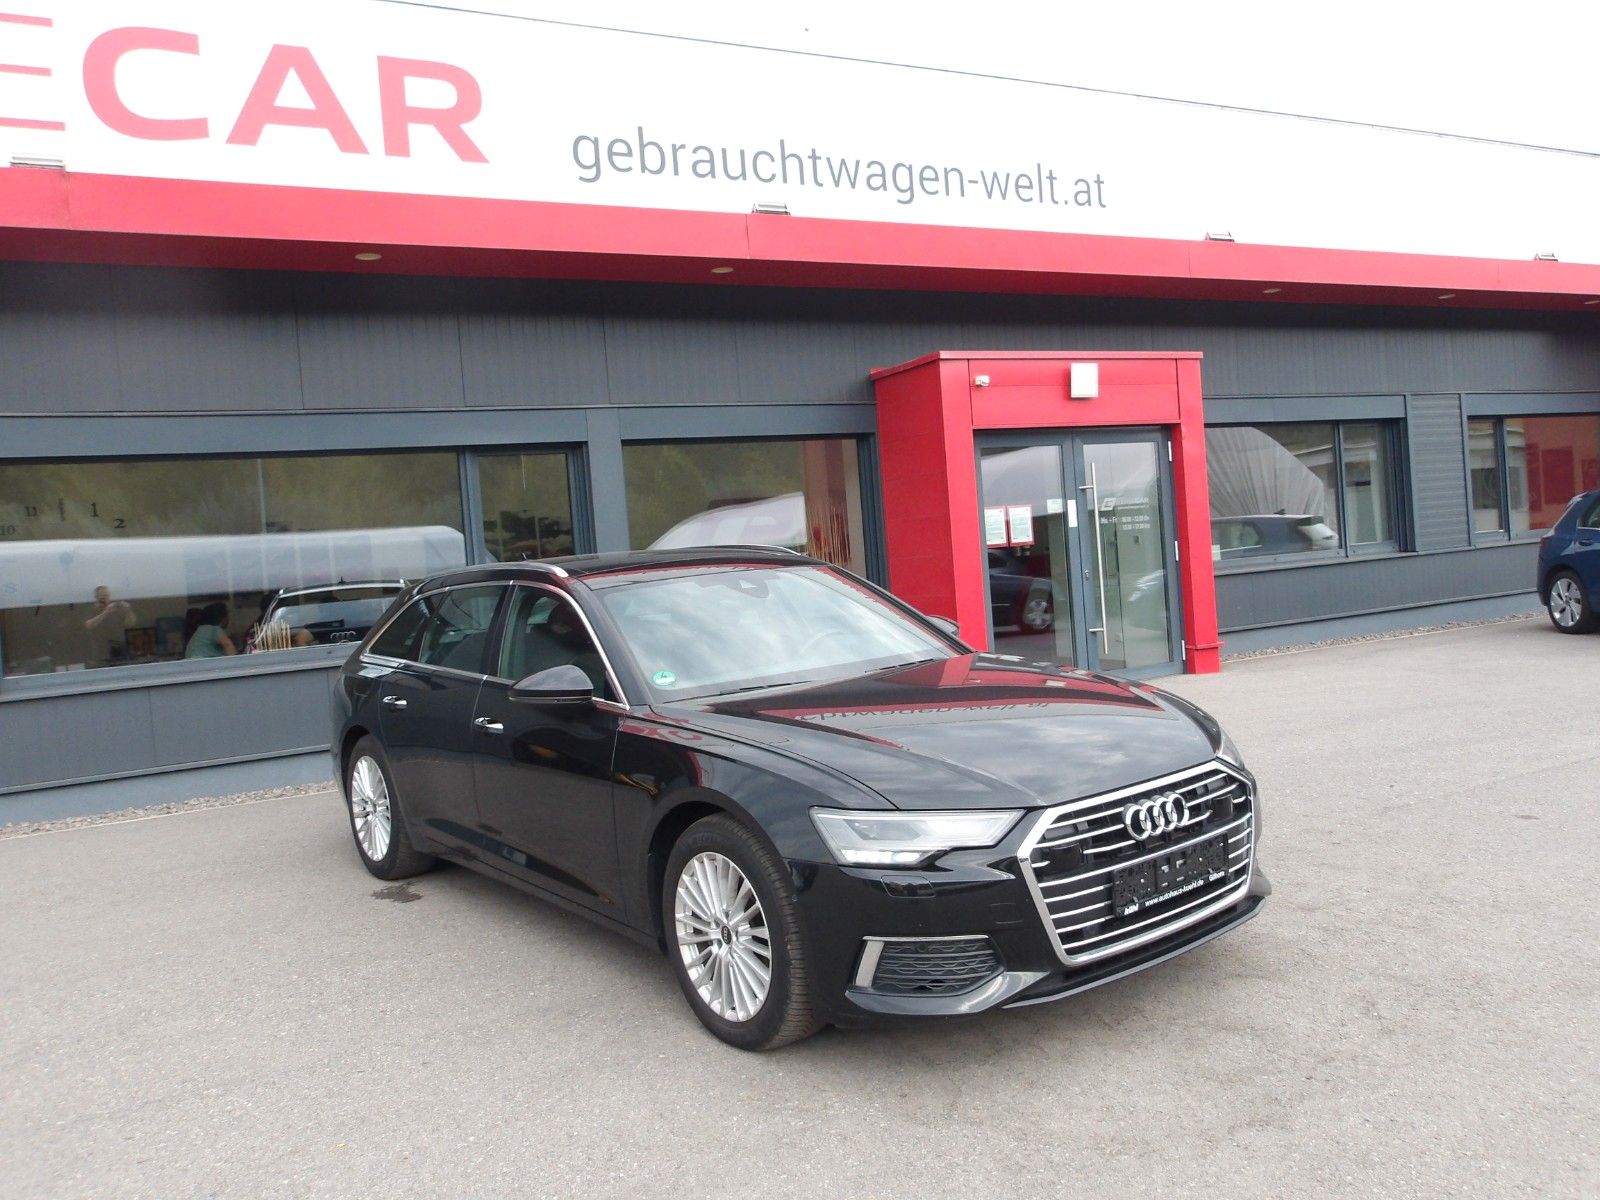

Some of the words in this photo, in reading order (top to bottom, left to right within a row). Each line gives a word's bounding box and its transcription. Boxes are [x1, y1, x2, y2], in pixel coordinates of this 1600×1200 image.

[572, 126, 1107, 209] gebrauchtwagen-welt.at
[114, 518, 127, 529] 2
[1144, 879, 1204, 907] www.autohaus-kuehl.de
